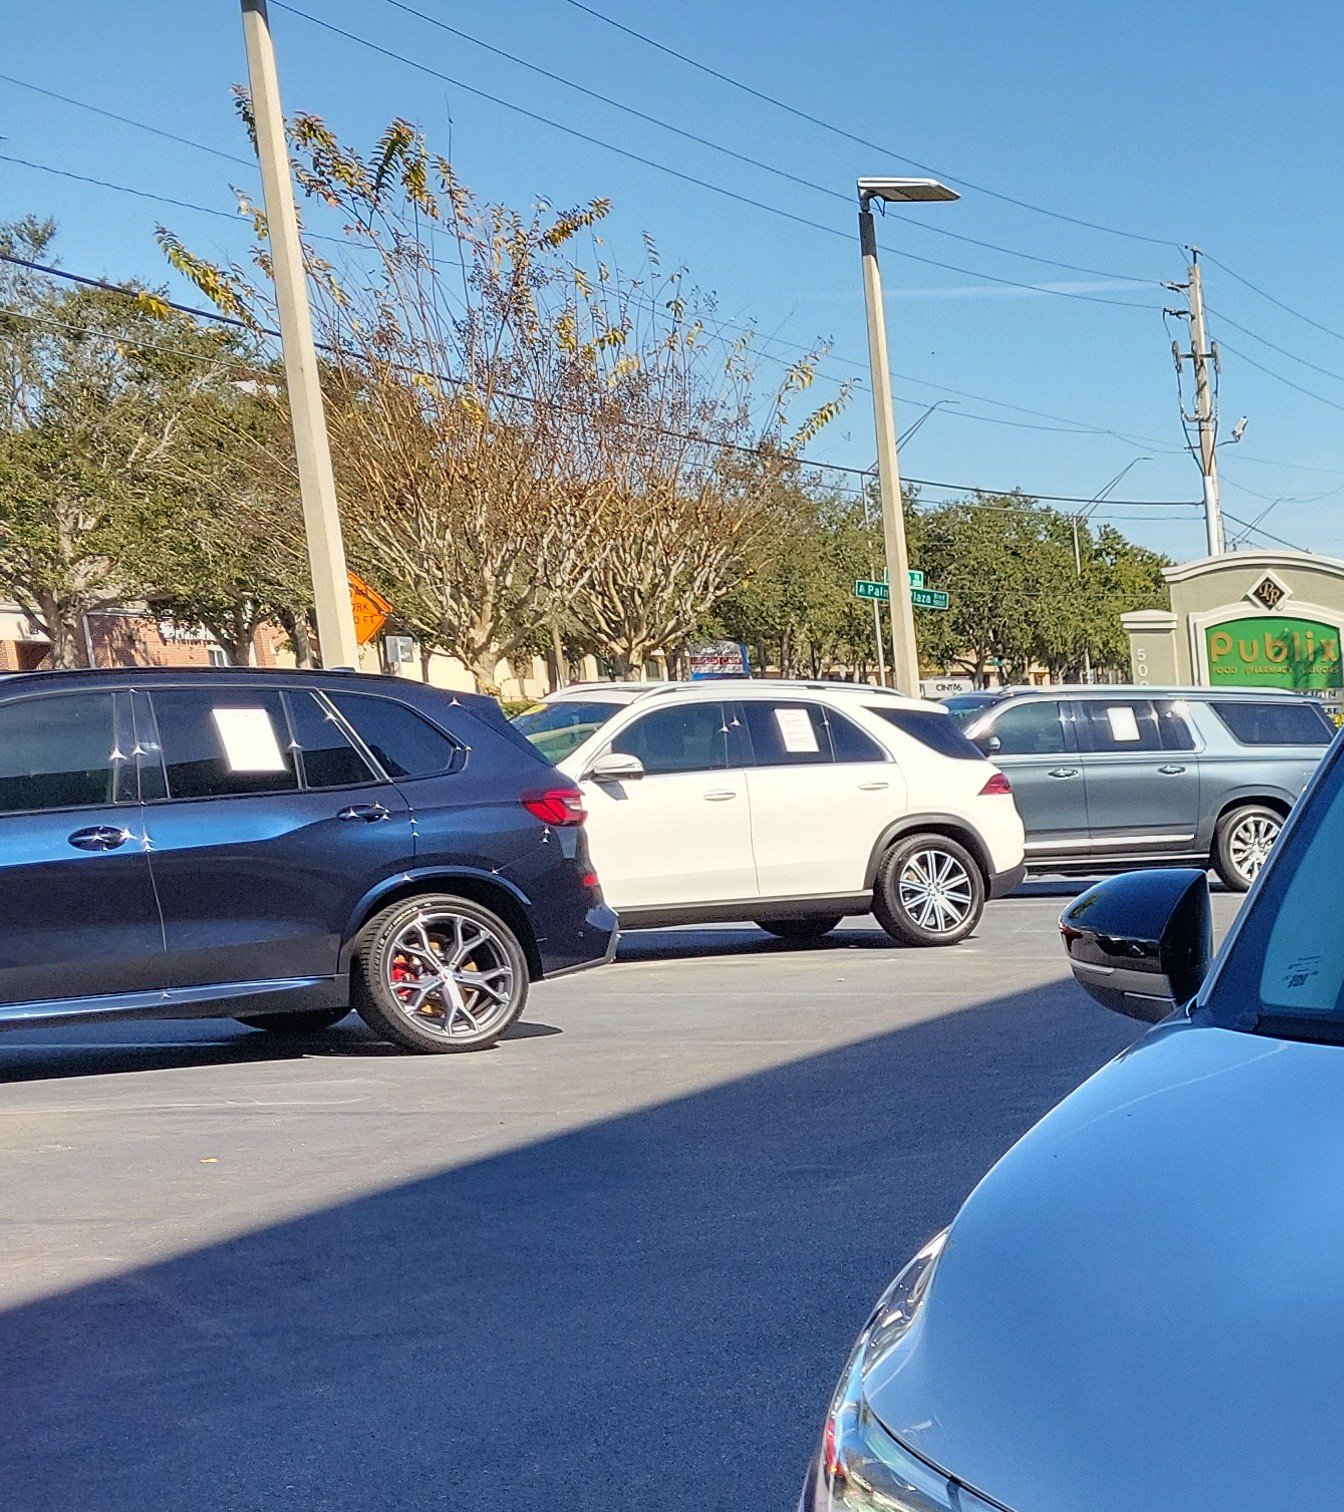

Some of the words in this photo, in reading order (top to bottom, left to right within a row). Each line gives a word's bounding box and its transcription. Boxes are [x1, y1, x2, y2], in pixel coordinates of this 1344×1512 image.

[910, 588, 932, 605] laza
[1210, 630, 1339, 663] Publix
[1244, 665, 1294, 676] PHARMACY
